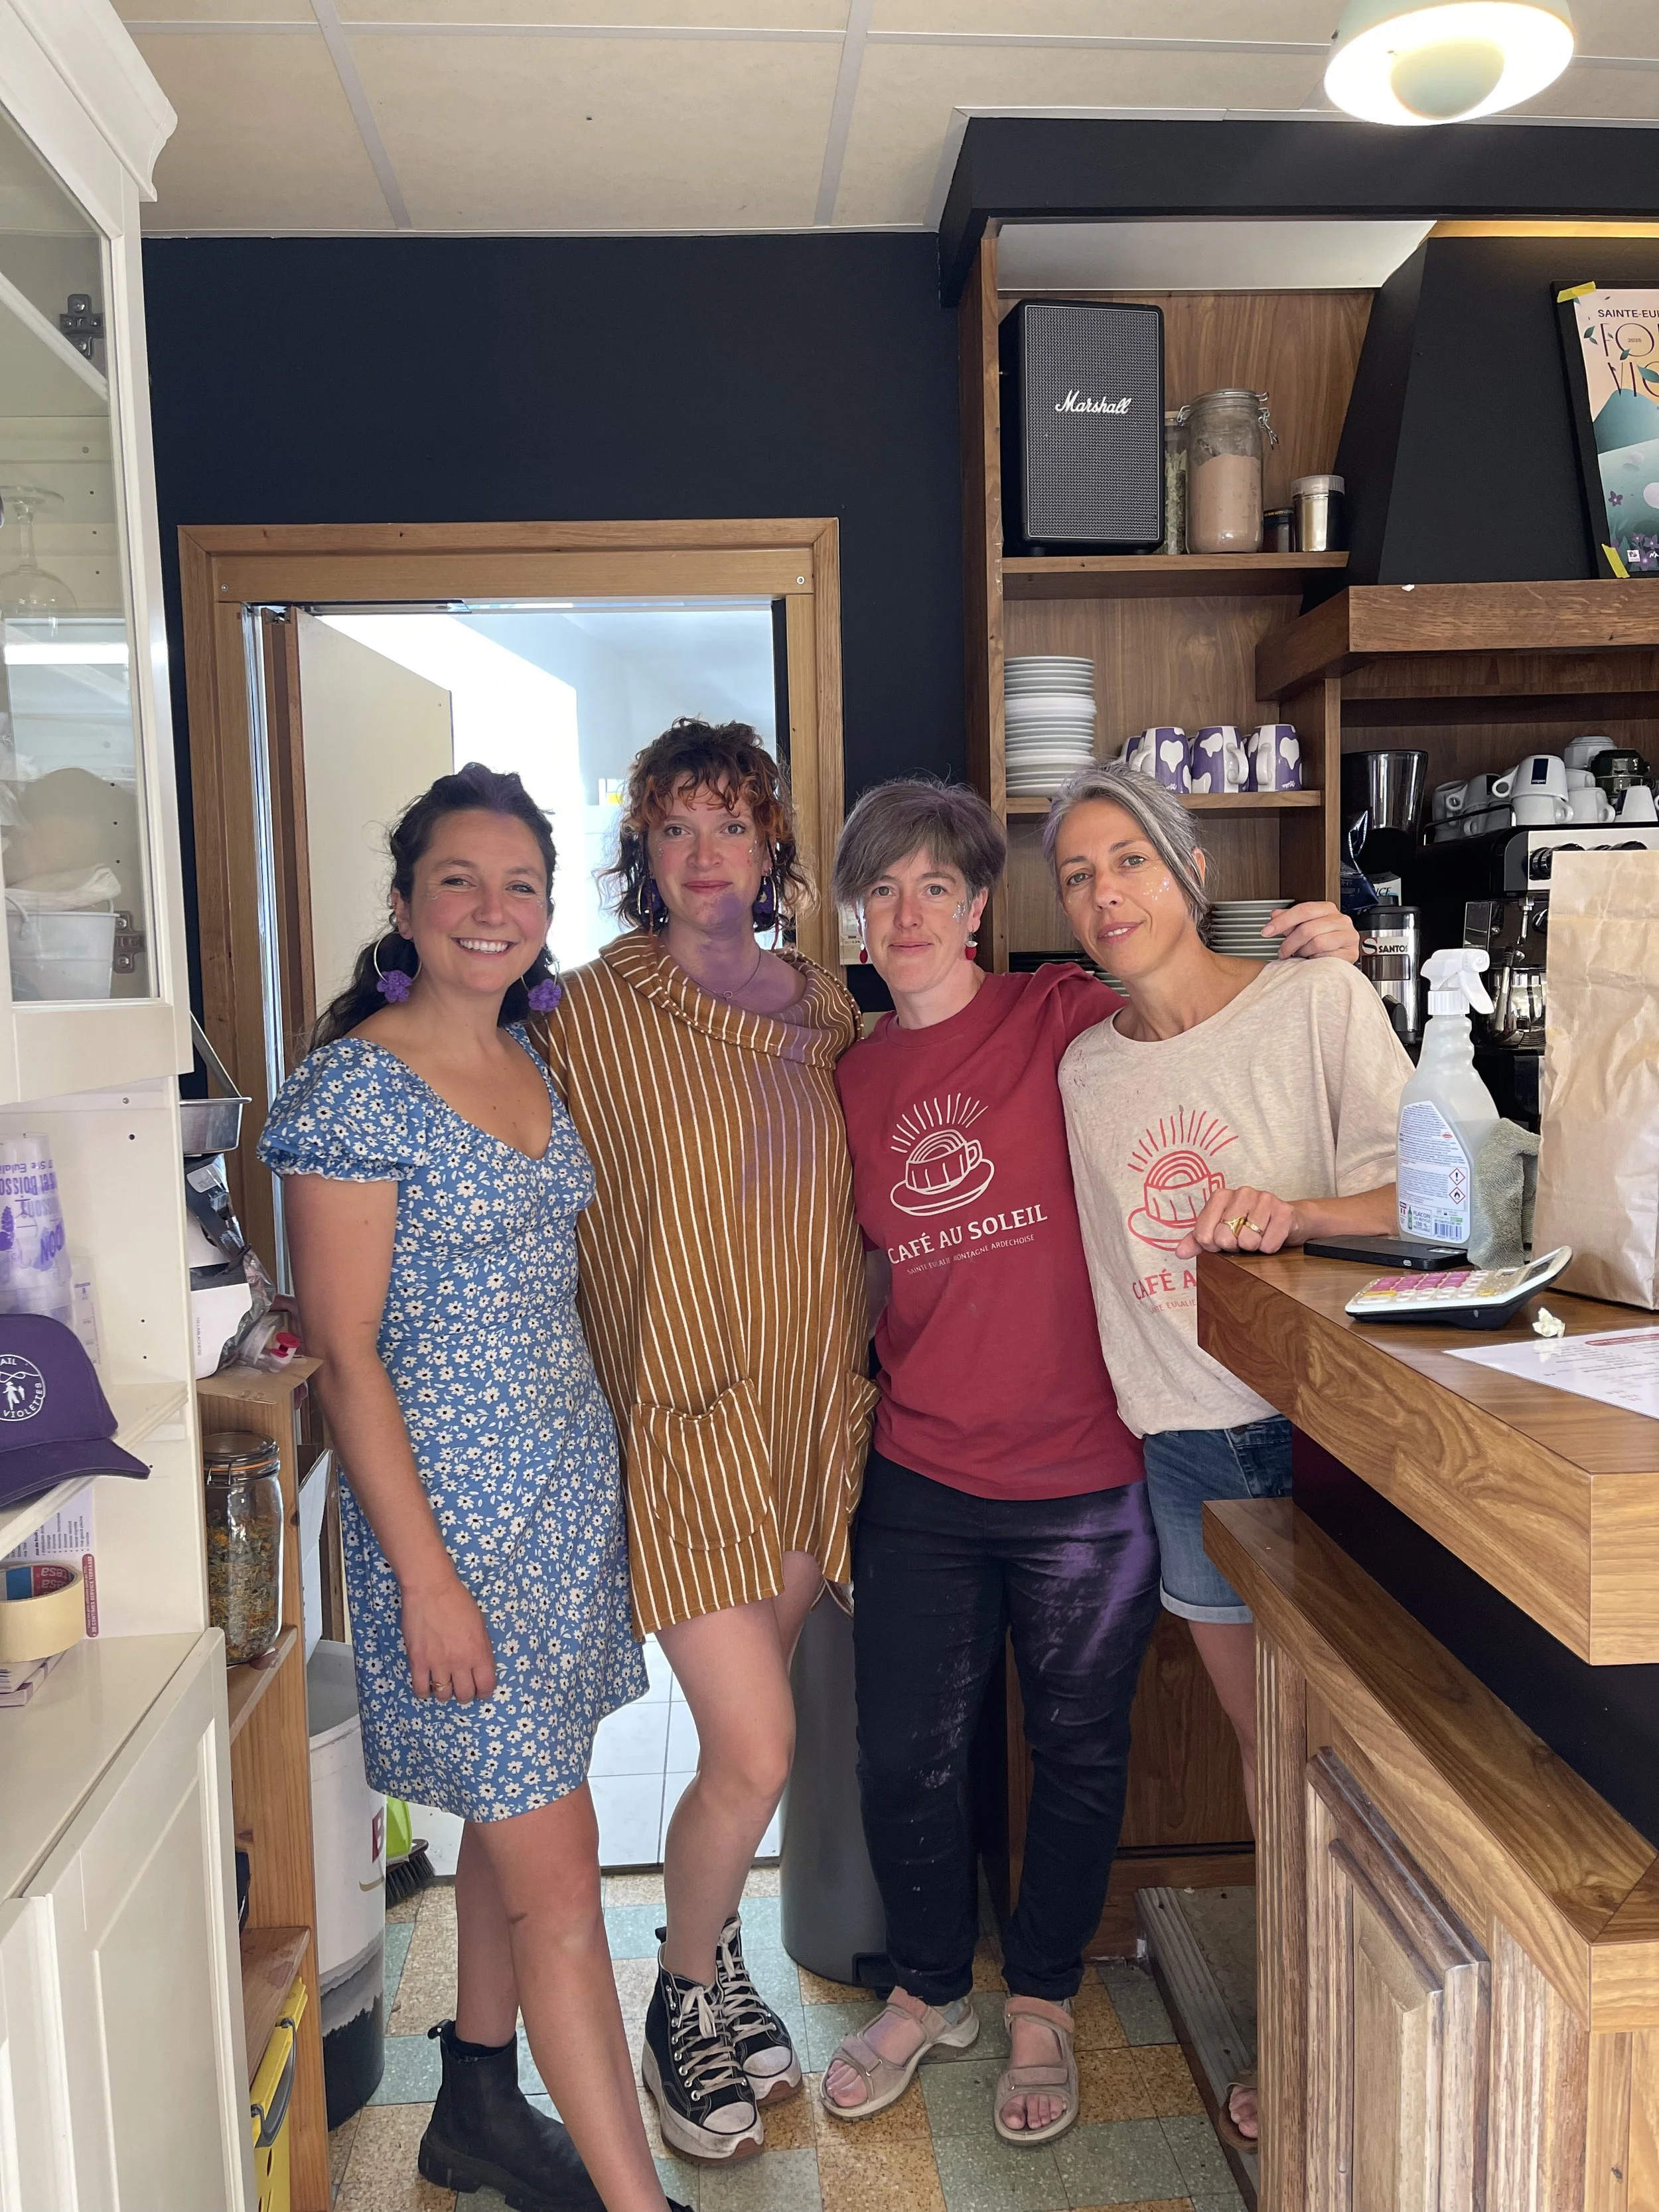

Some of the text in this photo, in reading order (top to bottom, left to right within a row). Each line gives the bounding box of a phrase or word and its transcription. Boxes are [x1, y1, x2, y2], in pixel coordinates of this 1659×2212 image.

[1600, 323, 1659, 357] FO
[1055, 390, 1131, 414] Marshall
[888, 1204, 1048, 1264] CAFÉ AU SOLEIL
[953, 1245, 989, 1262] MONTAGNE
[1132, 1269, 1196, 1301] CAFÉ A
